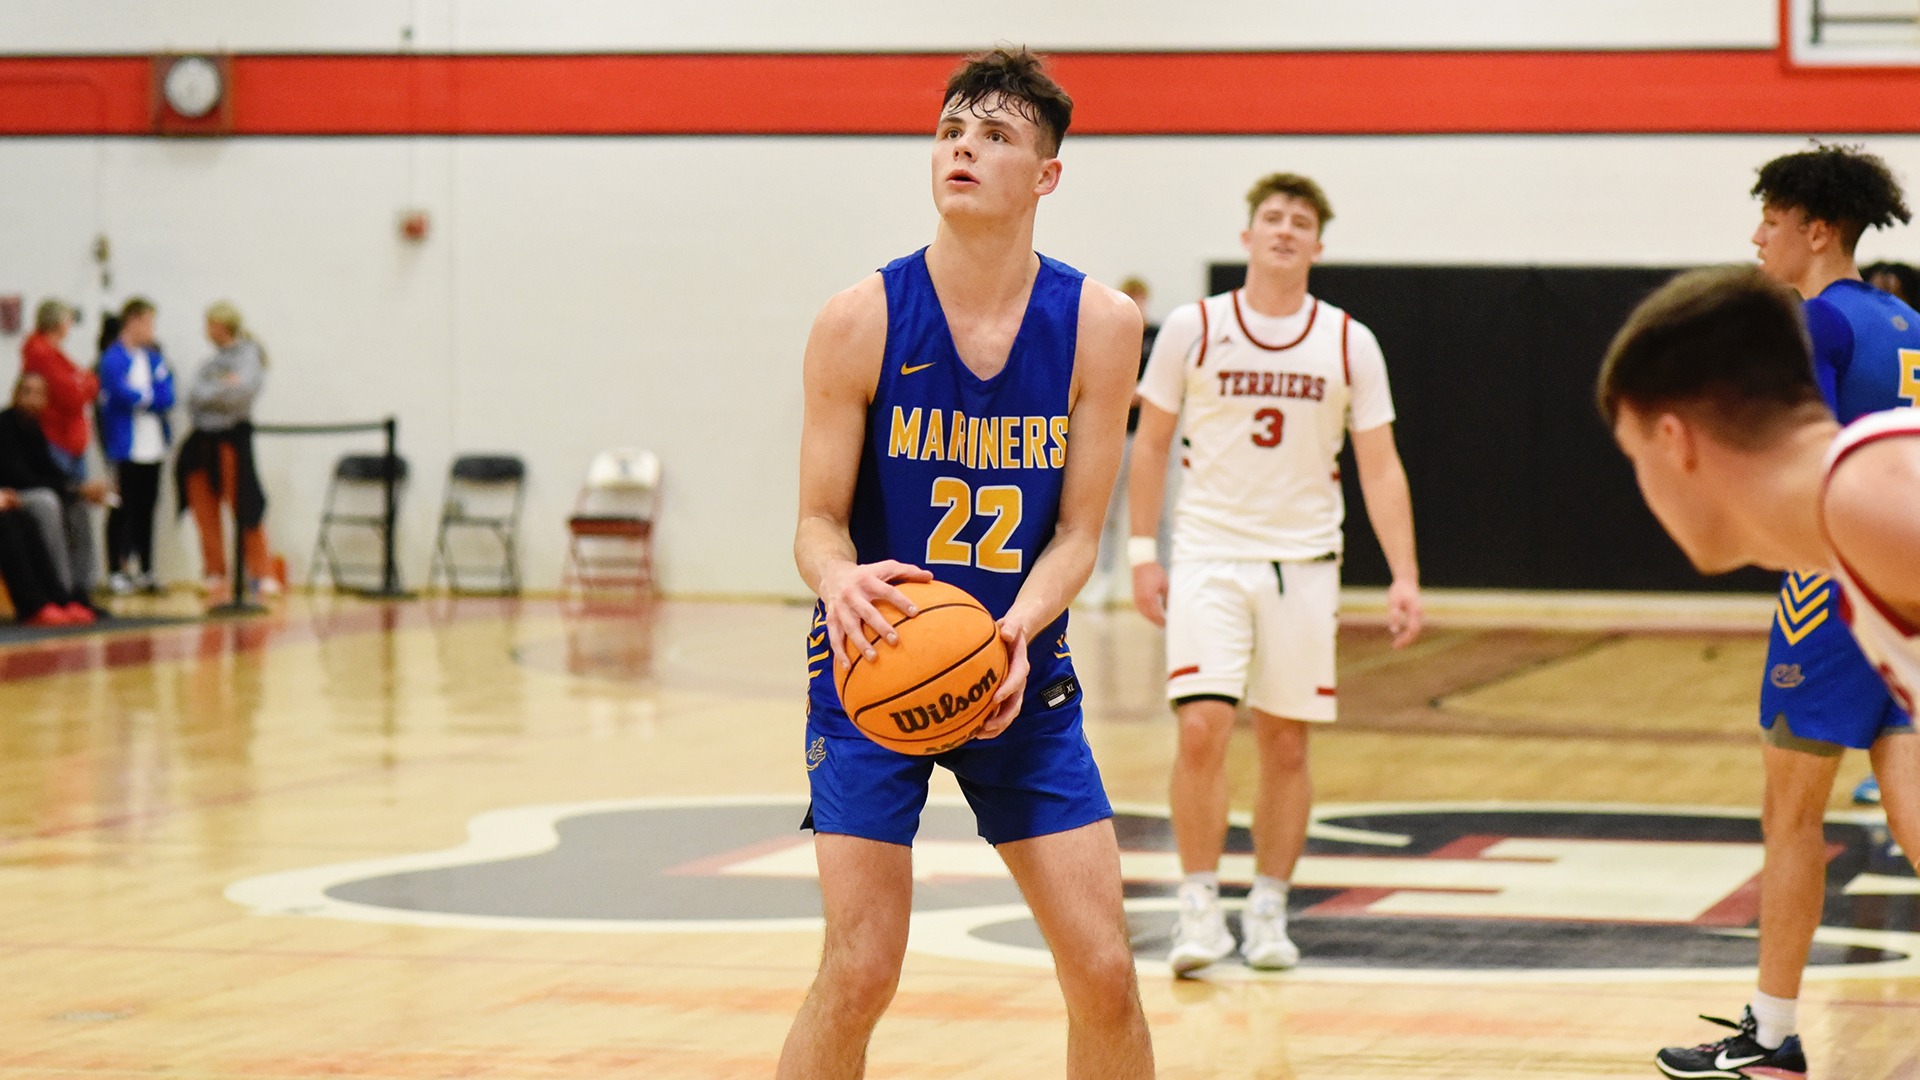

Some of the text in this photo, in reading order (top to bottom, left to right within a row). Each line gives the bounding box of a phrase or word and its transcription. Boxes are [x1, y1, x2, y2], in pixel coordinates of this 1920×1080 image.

[1217, 371, 1326, 402] TERRIERS
[888, 406, 1068, 469] MARINERS
[1251, 407, 1284, 447] 3
[925, 476, 1022, 573] 22
[889, 668, 998, 733] Wilson
[1066, 683, 1076, 694] XL
